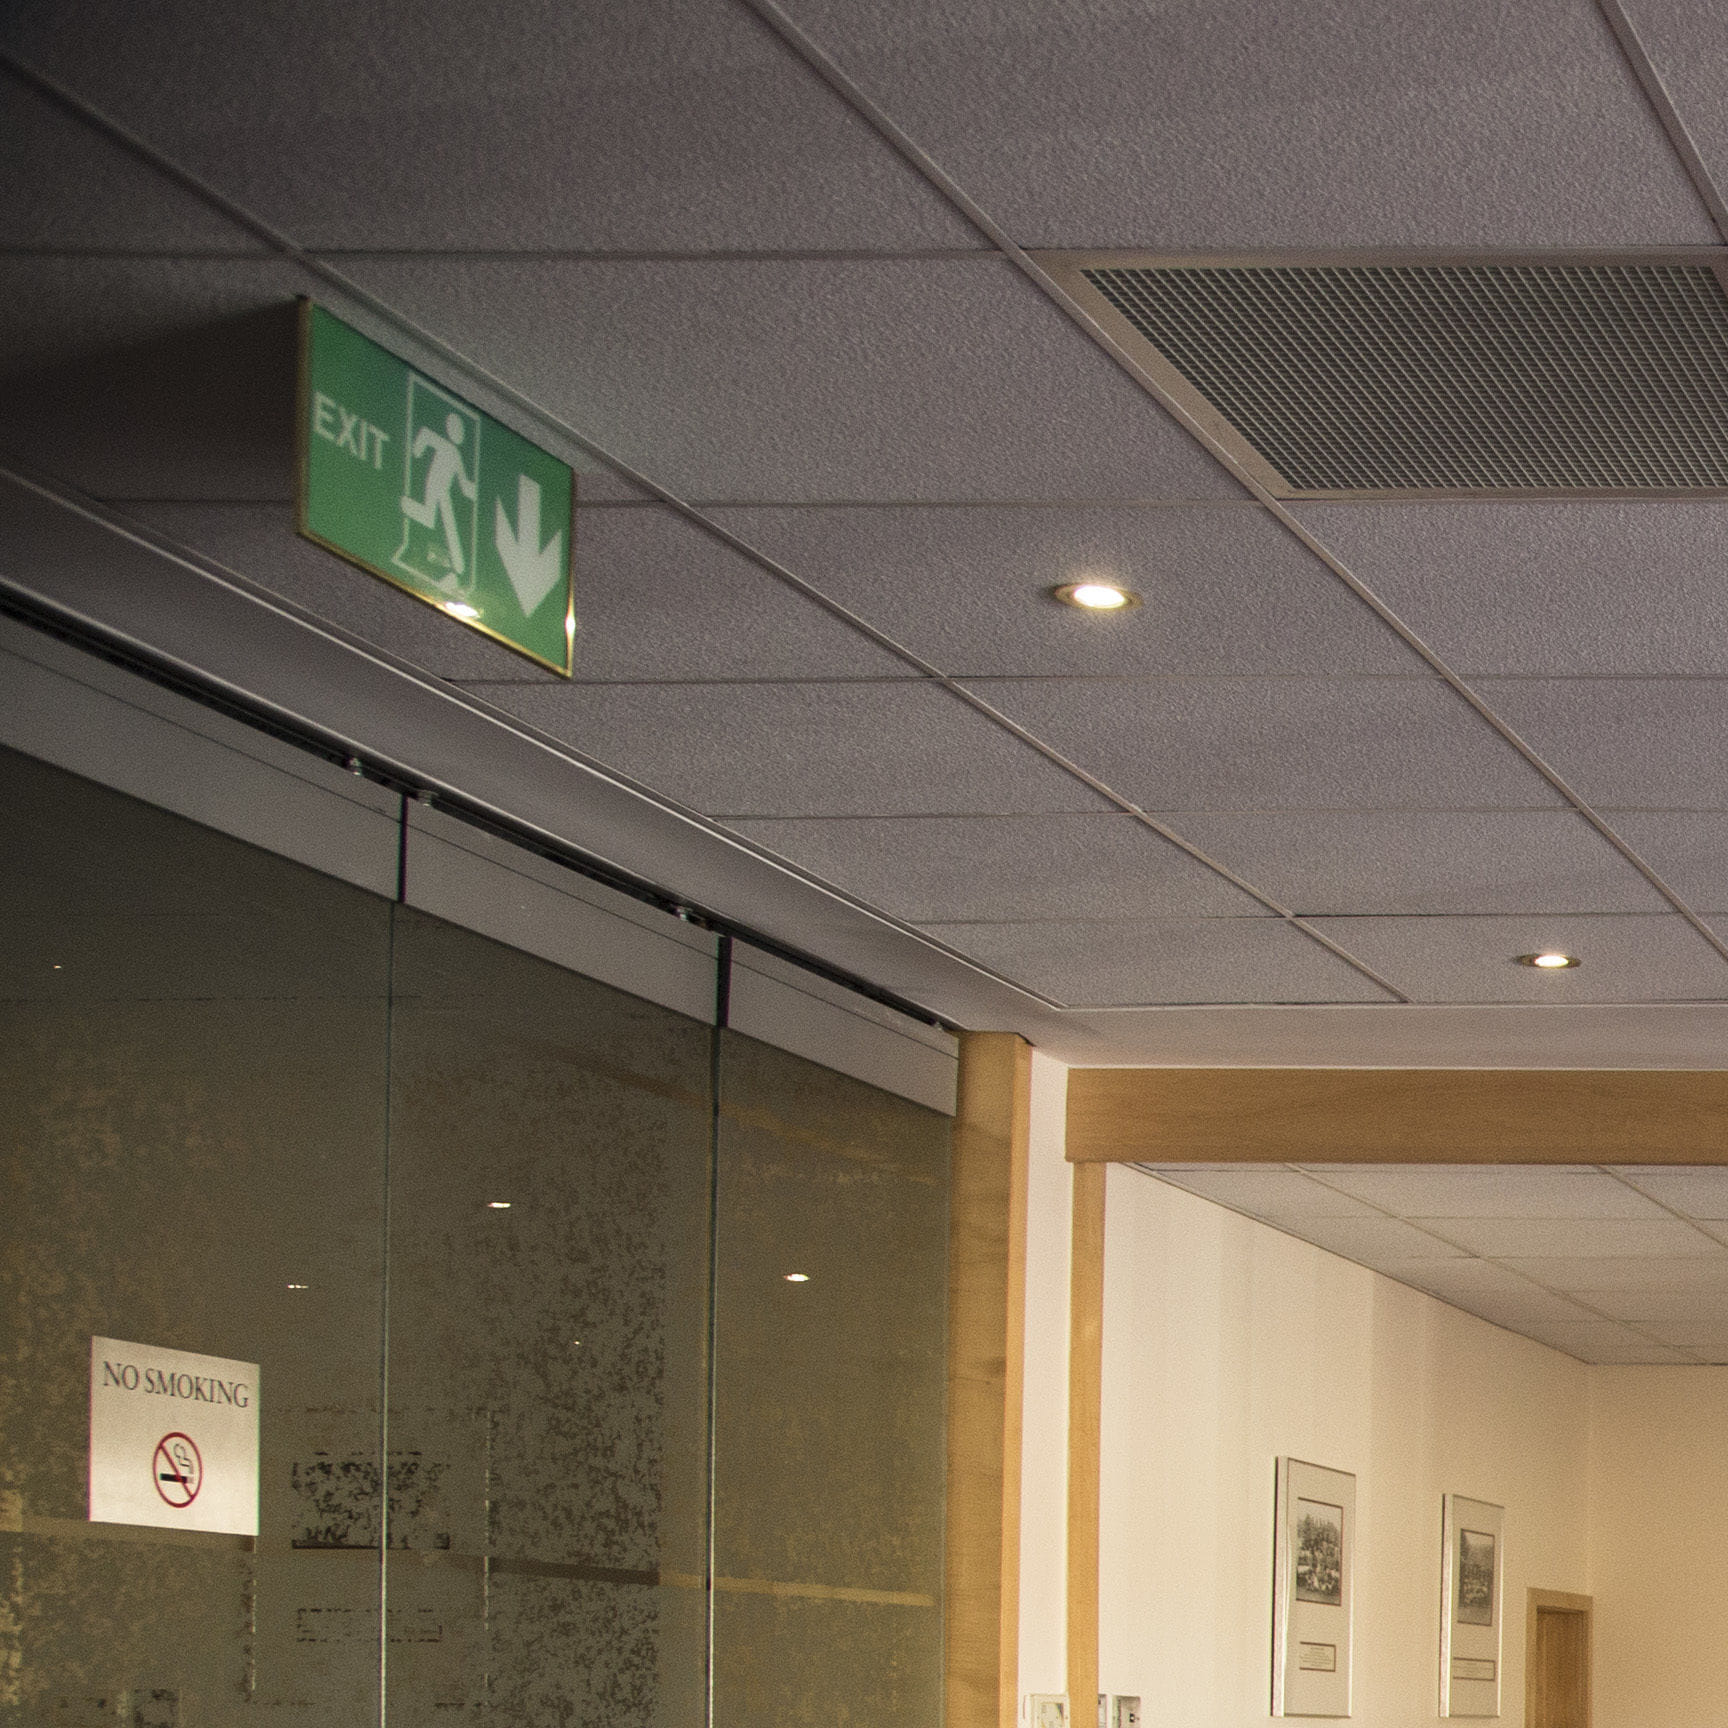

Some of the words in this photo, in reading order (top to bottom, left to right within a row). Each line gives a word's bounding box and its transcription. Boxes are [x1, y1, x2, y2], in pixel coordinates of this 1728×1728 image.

[314, 392, 390, 470] EXIT
[103, 1361, 139, 1391] NO
[145, 1368, 249, 1408] SMOKING
